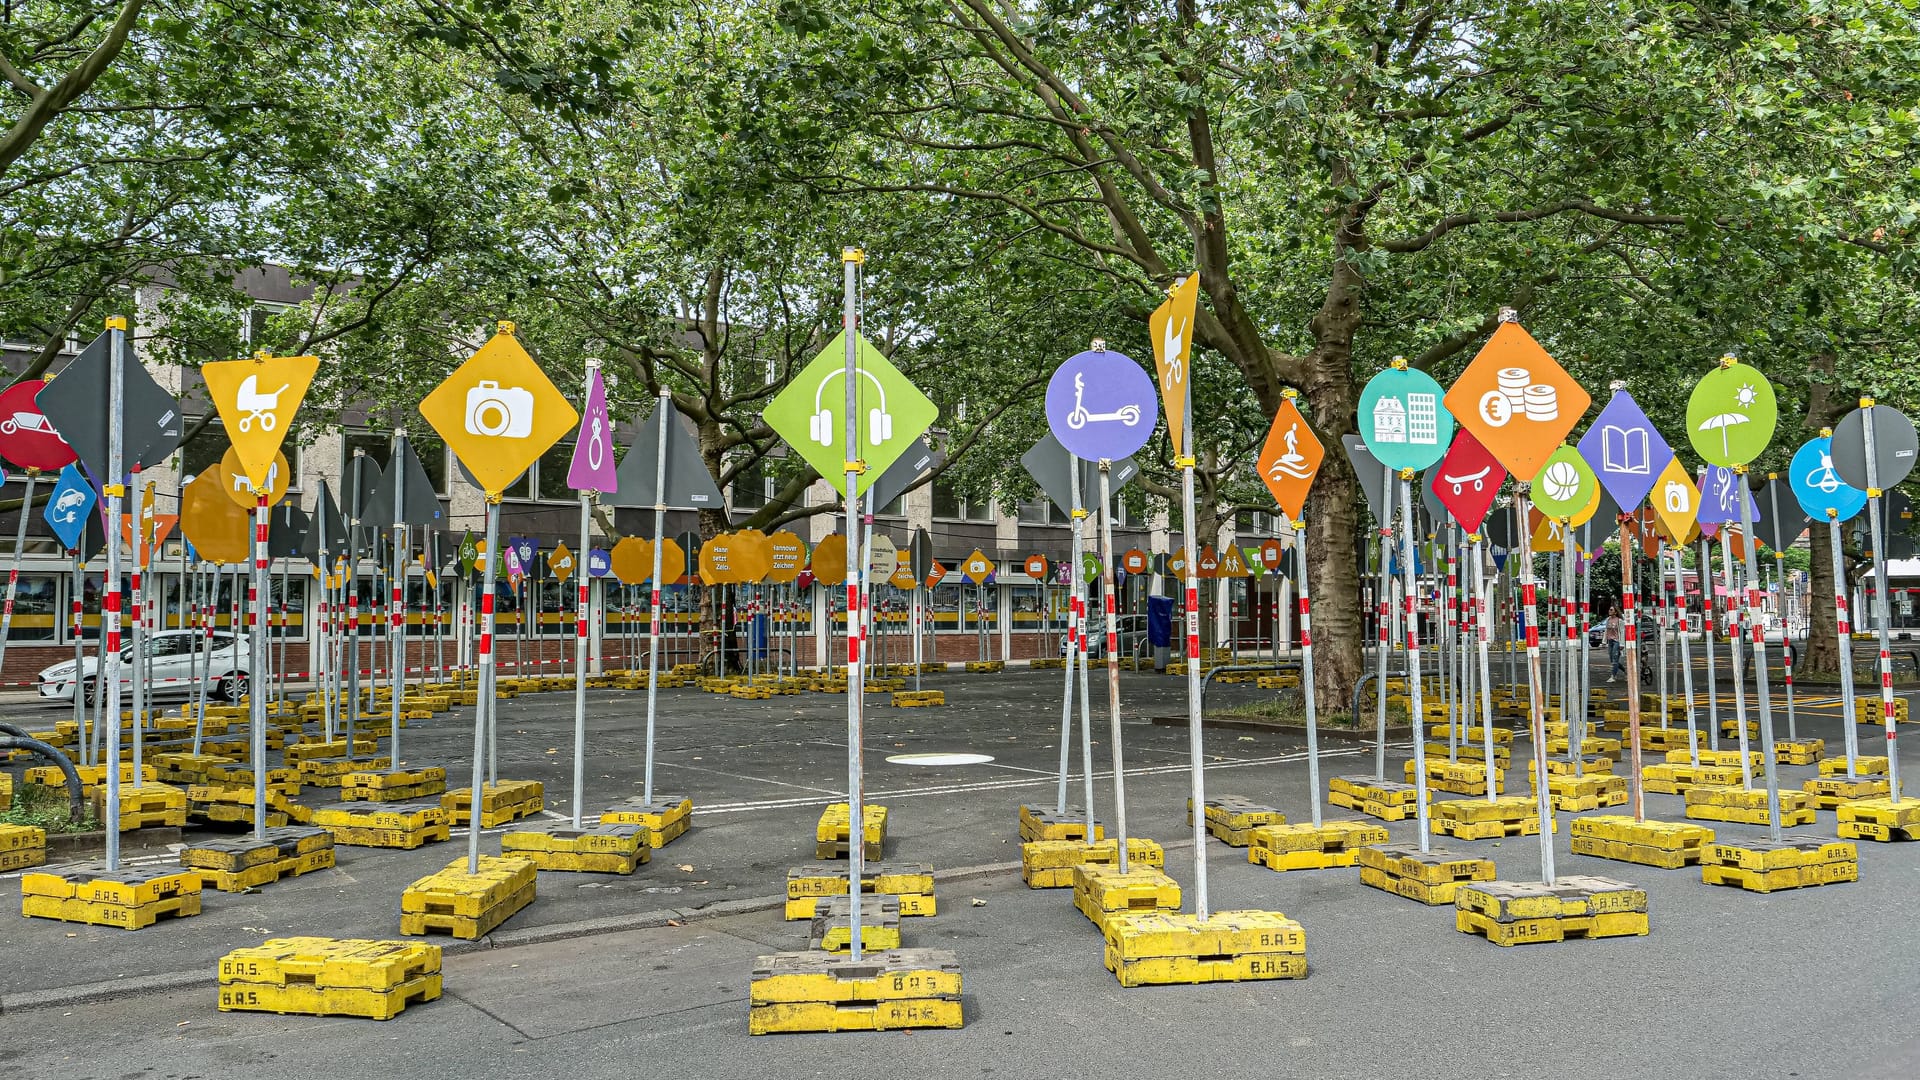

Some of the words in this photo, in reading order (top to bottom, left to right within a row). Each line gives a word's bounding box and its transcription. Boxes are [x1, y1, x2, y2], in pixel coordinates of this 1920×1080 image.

[1360, 833, 1387, 842] B.A.S.
[1716, 850, 1746, 862] B.A.S.
[900, 902, 922, 911] A.S.
[1261, 934, 1301, 946] B.A.S.
[224, 963, 261, 976] B.A.S.
[1251, 962, 1294, 974] B.A.S.
[223, 992, 261, 1005] B.A.S.
